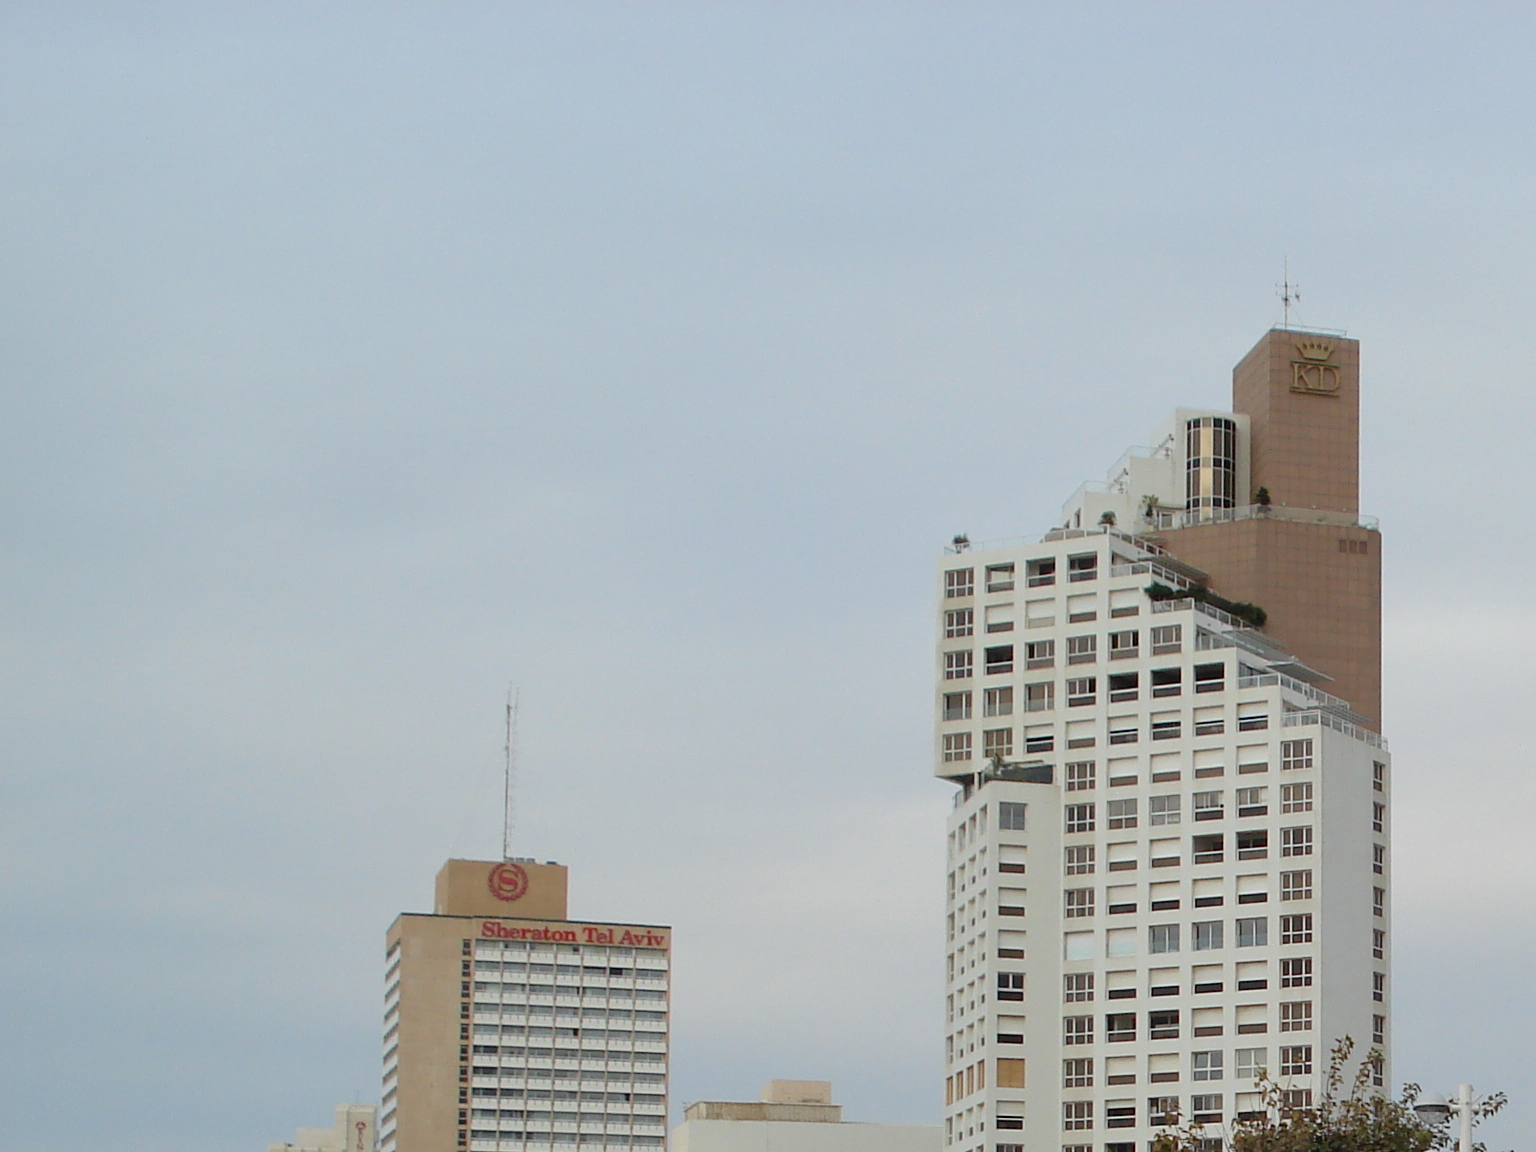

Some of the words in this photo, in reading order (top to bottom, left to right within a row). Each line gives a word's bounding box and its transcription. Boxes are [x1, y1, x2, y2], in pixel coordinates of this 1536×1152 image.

[1292, 363, 1341, 392] KD
[498, 869, 520, 893] S
[481, 921, 577, 943] Sheraton
[583, 926, 614, 944] Tel
[619, 929, 665, 947] Aviv
